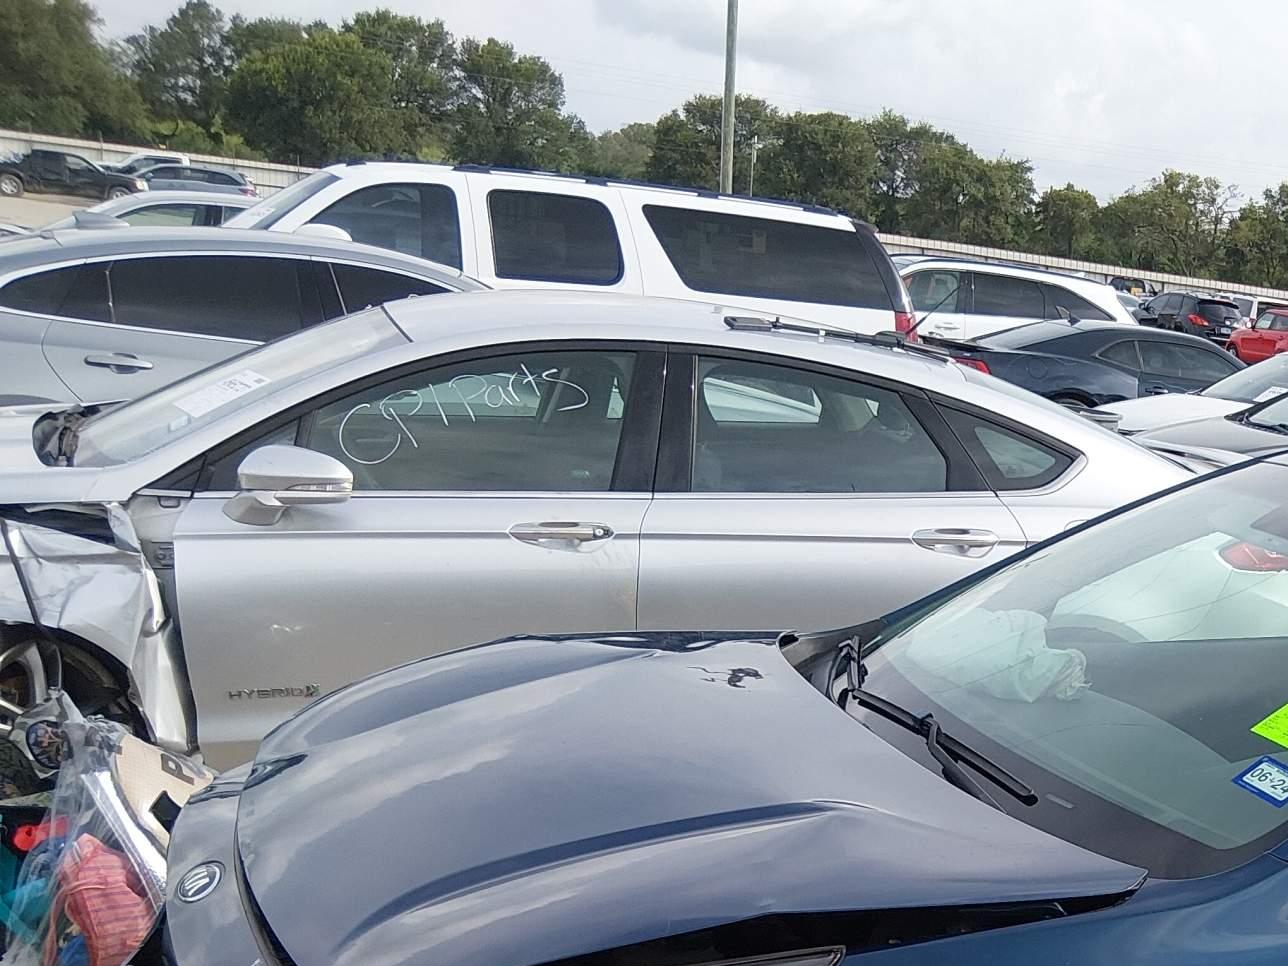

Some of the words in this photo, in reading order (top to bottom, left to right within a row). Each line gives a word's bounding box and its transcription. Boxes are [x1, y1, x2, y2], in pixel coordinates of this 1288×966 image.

[449, 363, 589, 422] Parts
[228, 686, 304, 700] HYBRID
[1250, 767, 1273, 783] 06
